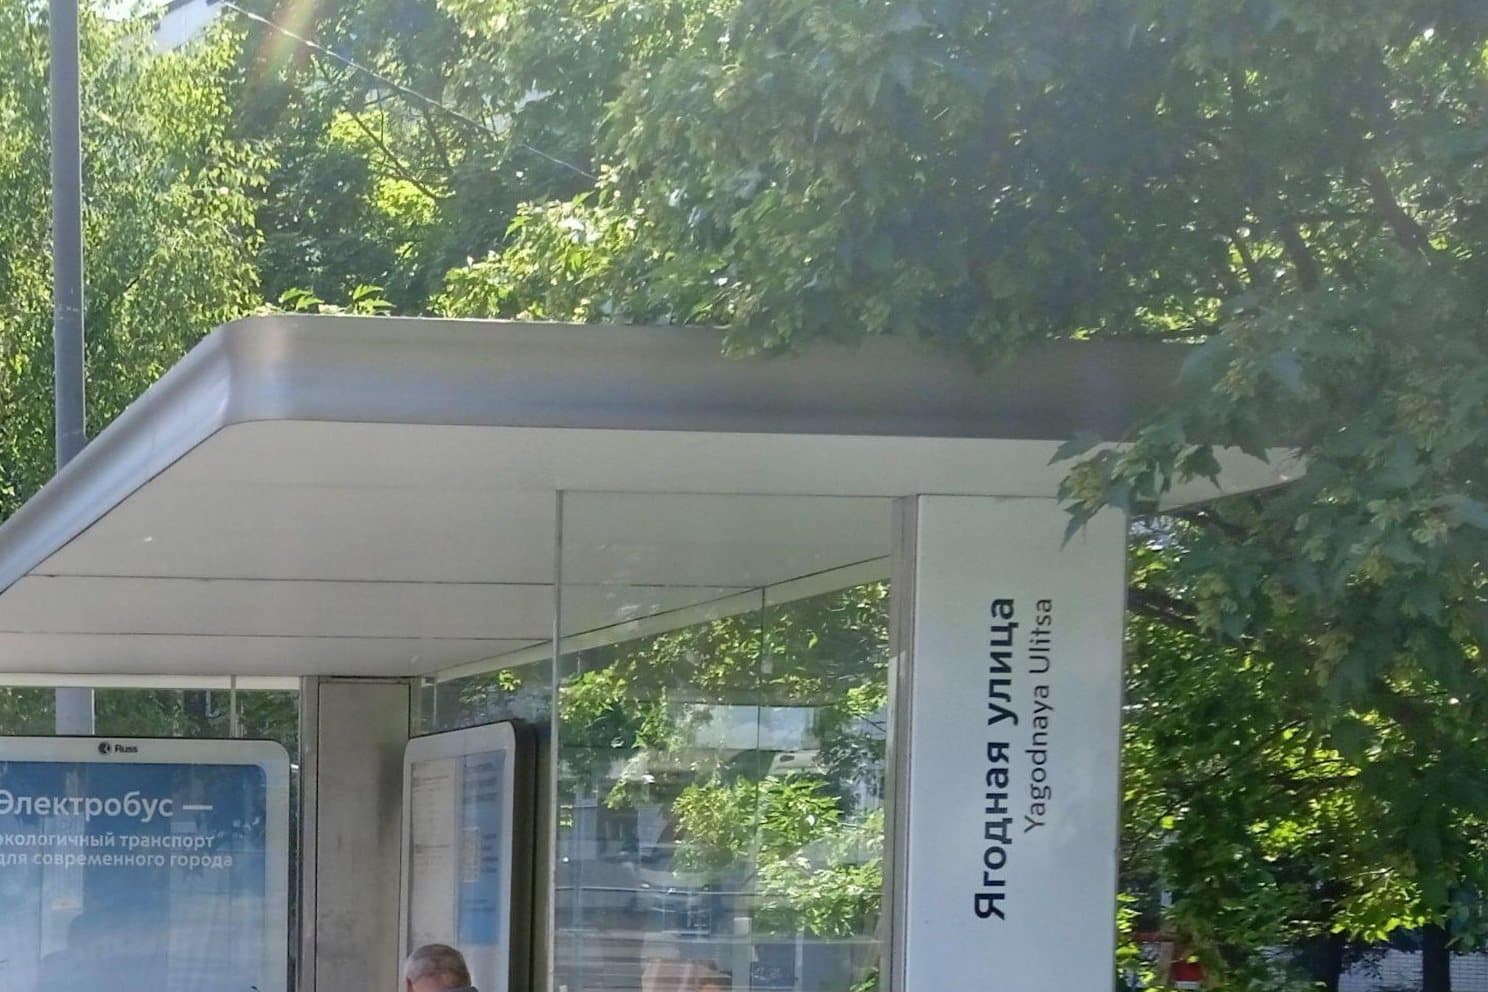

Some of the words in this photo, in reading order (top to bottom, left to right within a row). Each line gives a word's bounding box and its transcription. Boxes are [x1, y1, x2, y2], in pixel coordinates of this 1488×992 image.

[987, 598, 1019, 726] улица
[1028, 599, 1053, 674] Ulitsa
[114, 745, 138, 753] Russ
[1023, 684, 1054, 833] Yagodnaya
[32, 853, 164, 869] современного
[170, 854, 233, 869] города
[120, 834, 214, 851] транспорт
[974, 742, 1013, 921] Ягодная
